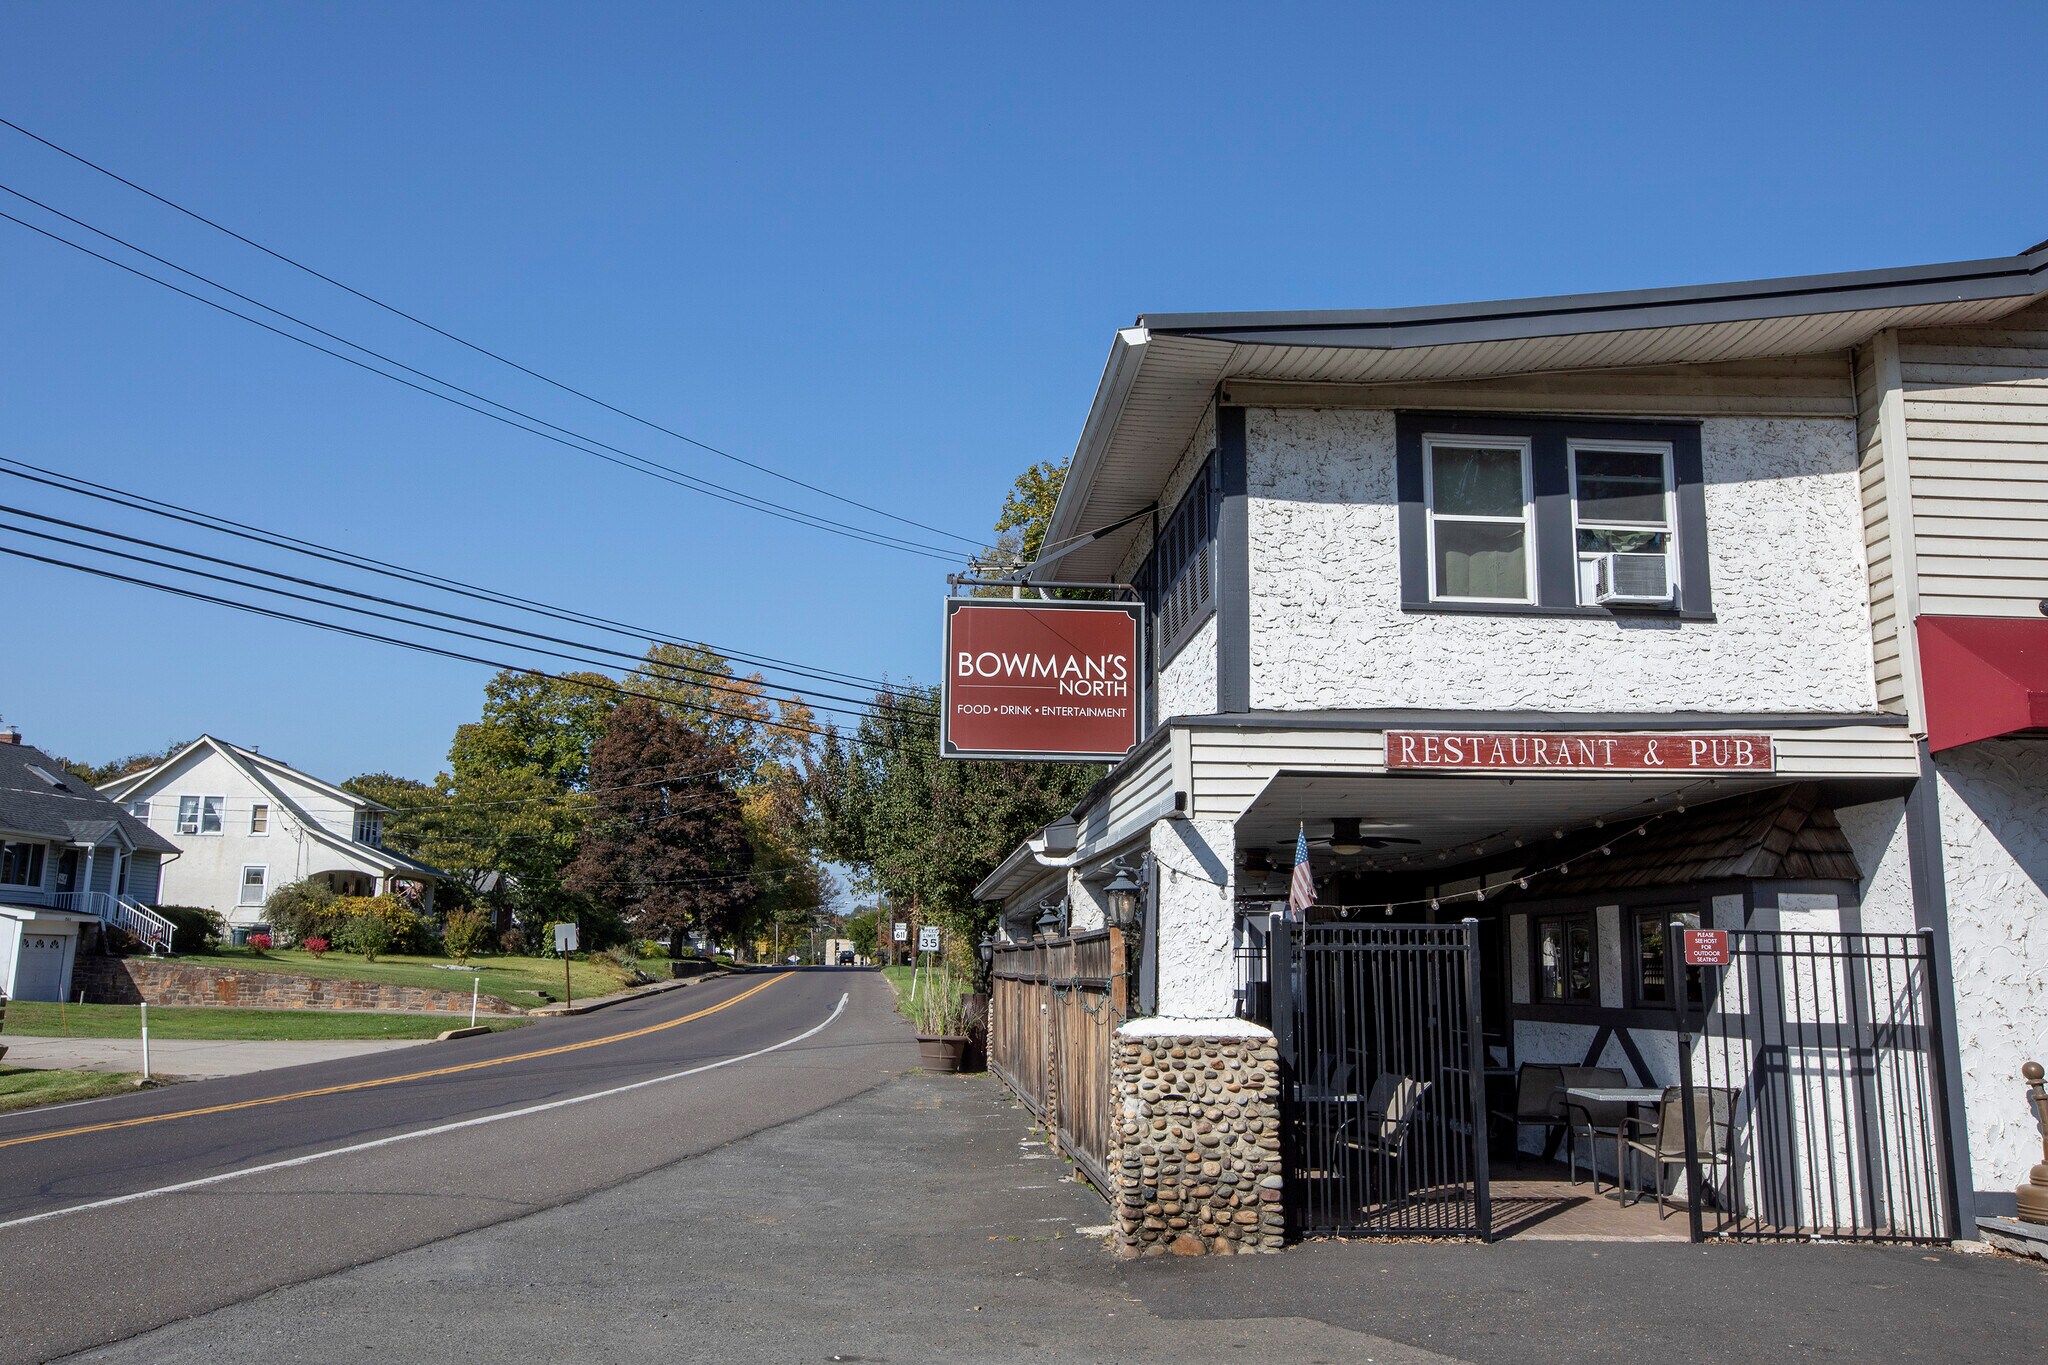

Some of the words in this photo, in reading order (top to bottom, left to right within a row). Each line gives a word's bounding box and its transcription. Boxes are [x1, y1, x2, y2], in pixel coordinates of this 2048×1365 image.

[958, 652, 1128, 681] BOWMAN'S
[1059, 680, 1127, 697] NORTH
[957, 704, 991, 715] FOOD
[1000, 705, 1032, 716] DRINK
[1041, 706, 1127, 718] ENTERTAINMENT
[1400, 735, 1618, 765] RESTAURANT
[1643, 738, 1665, 766] &
[1688, 738, 1754, 767] PUB
[921, 938, 937, 948] 35
